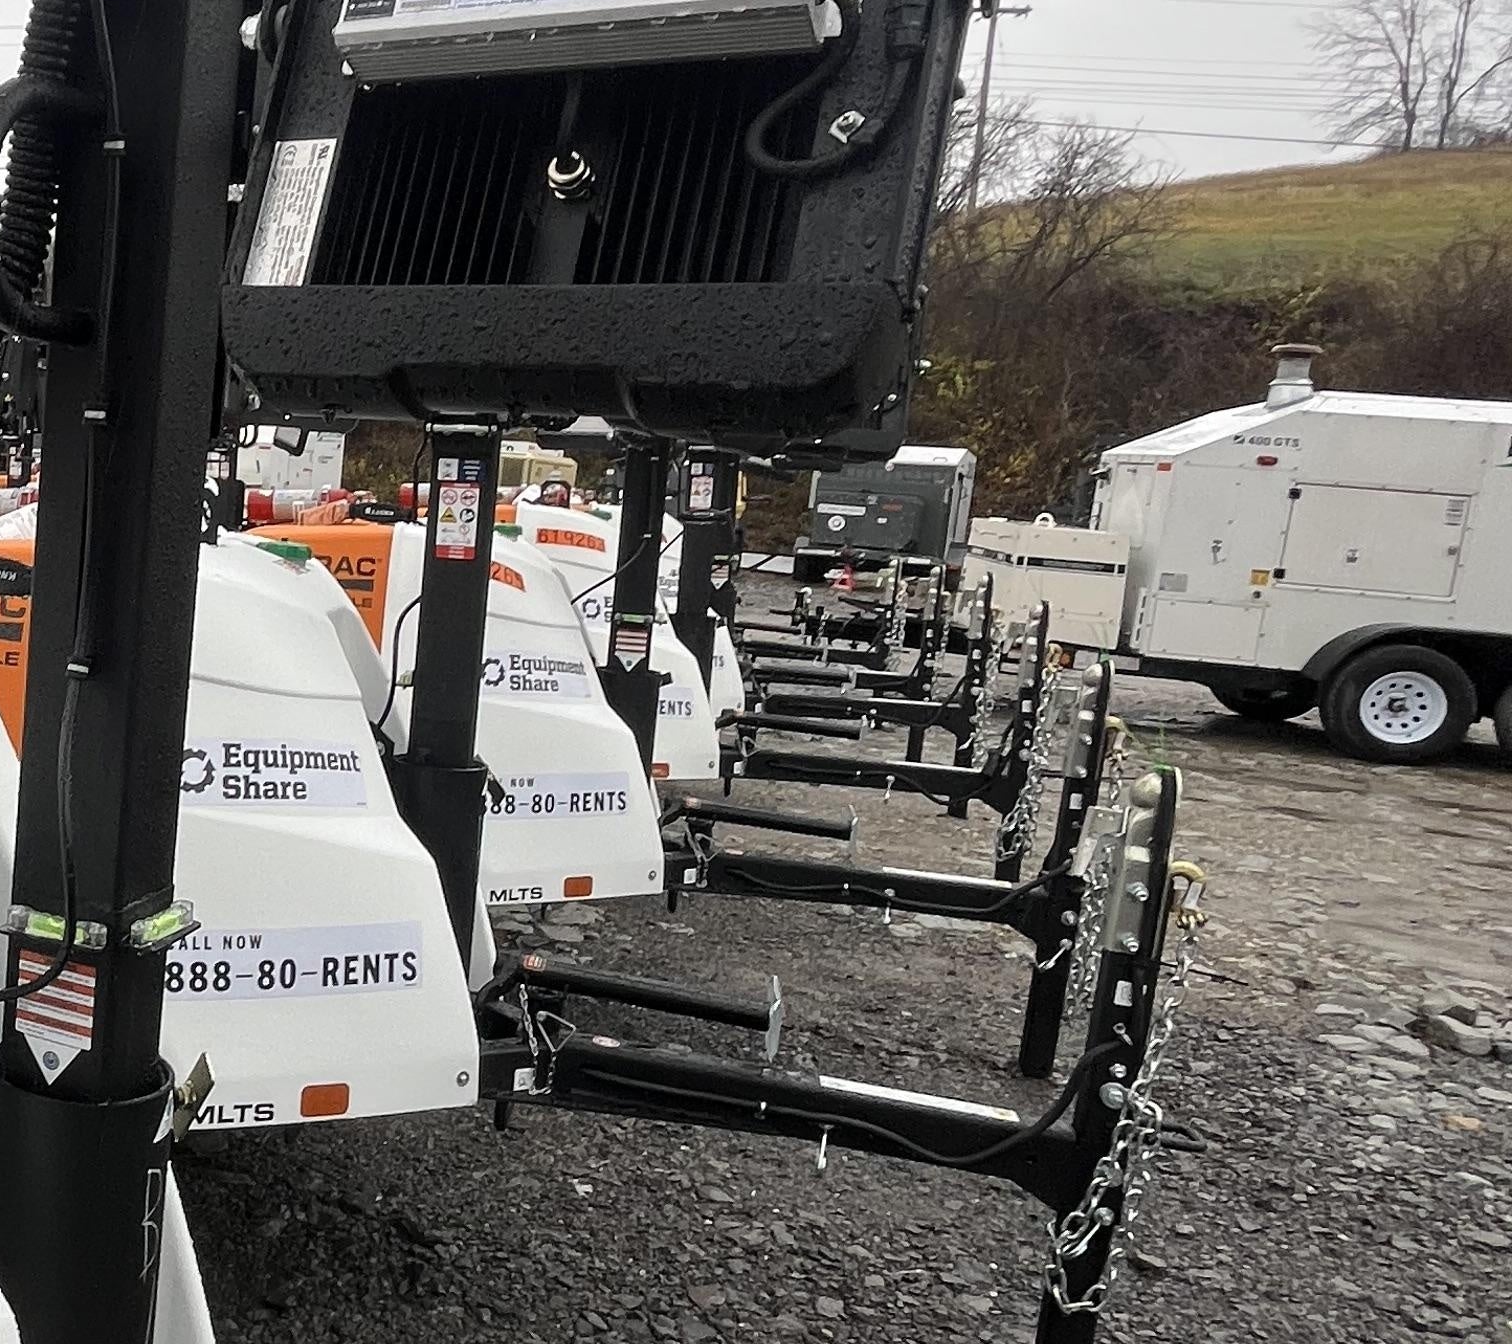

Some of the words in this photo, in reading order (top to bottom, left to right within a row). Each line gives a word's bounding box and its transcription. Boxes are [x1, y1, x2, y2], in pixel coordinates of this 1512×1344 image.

[1248, 436, 1271, 447] 400
[1273, 437, 1300, 448] GTS
[509, 654, 586, 675] Equipment
[509, 674, 559, 693] Share
[222, 743, 361, 774] Equipment
[222, 774, 307, 800] Share
[489, 887, 544, 902] MLTS
[222, 935, 262, 950] NOW
[166, 951, 417, 993] 888-80-RENTS
